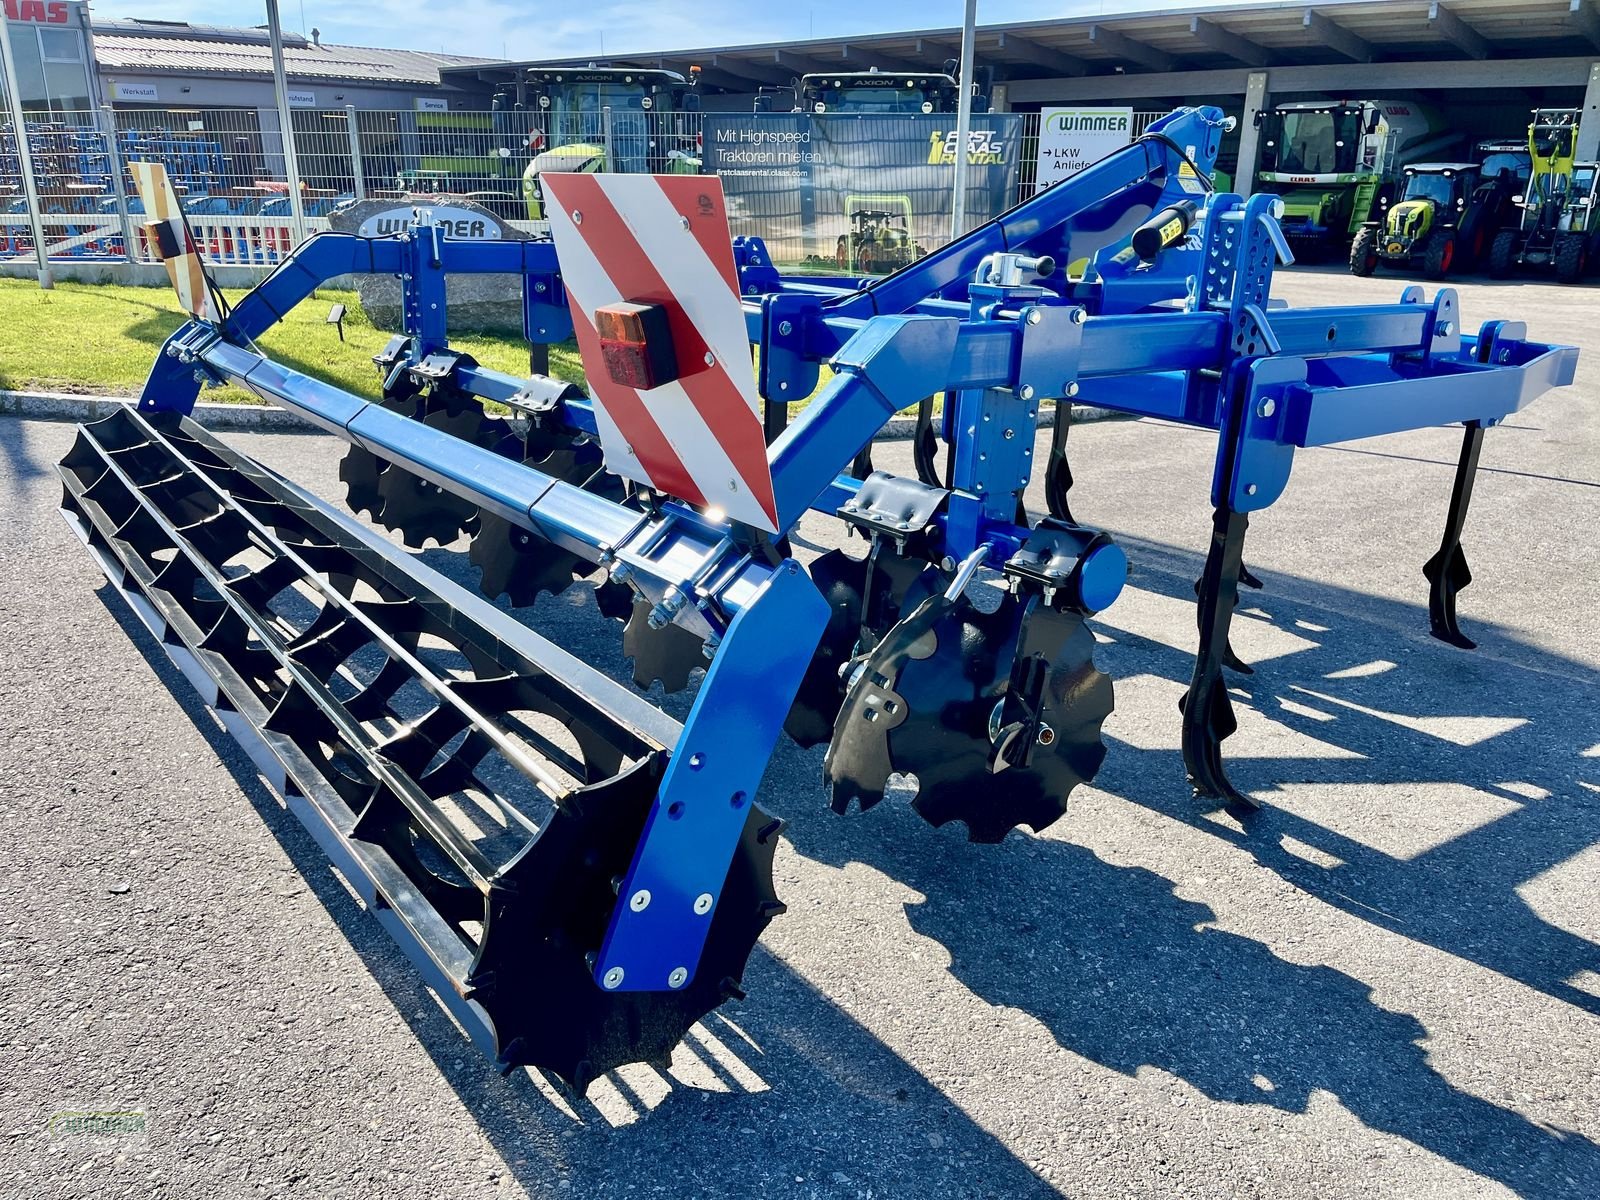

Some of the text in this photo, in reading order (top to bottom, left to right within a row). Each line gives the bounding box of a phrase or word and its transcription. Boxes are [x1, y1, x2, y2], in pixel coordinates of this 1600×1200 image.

[122, 87, 155, 96] Werkstatt
[1059, 116, 1128, 131] WIMMER
[717, 129, 811, 146] Mit Highspeed
[716, 149, 826, 163] Traktoren mieten.
[1054, 148, 1081, 158] LKW
[716, 168, 808, 177] firstclaasrental.claas.com
[376, 218, 485, 238] WIMER
